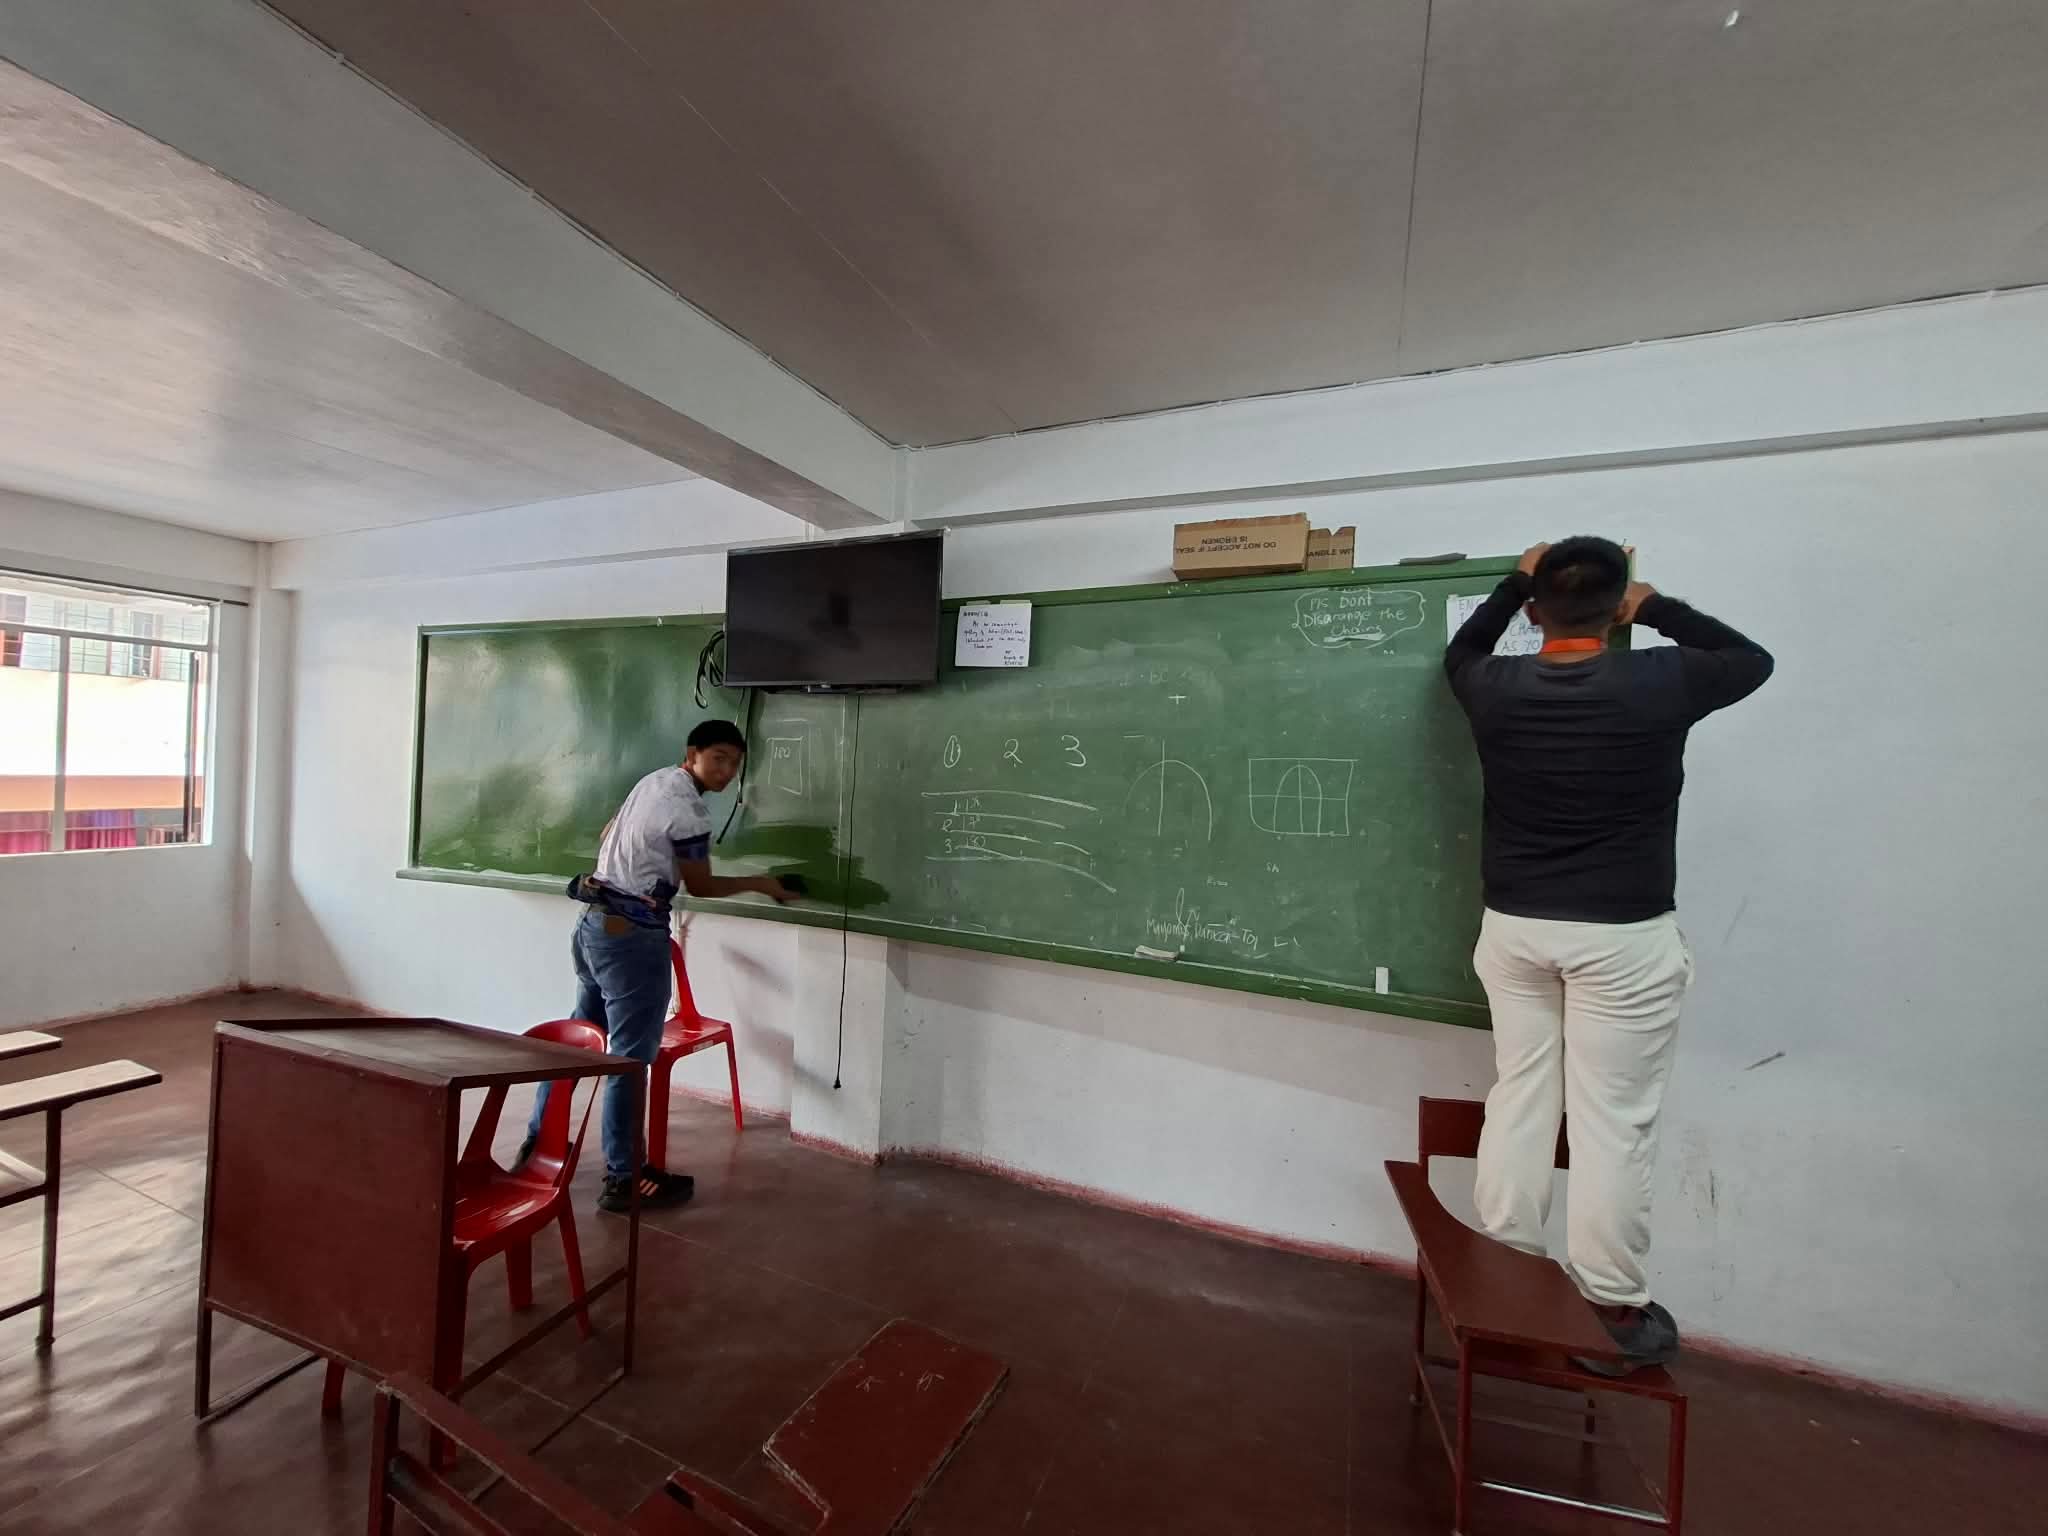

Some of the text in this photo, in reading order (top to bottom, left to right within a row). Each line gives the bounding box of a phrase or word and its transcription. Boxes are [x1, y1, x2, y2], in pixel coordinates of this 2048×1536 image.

[1201, 535, 1248, 545] IS BROKEN
[1263, 541, 1277, 549] DO
[1208, 543, 1241, 553] ACCEPT
[1243, 542, 1261, 550] NOT
[1381, 607, 1408, 621] the
[1003, 738, 1024, 767] 2
[1061, 734, 1087, 767] 3
[944, 838, 953, 854] 3
